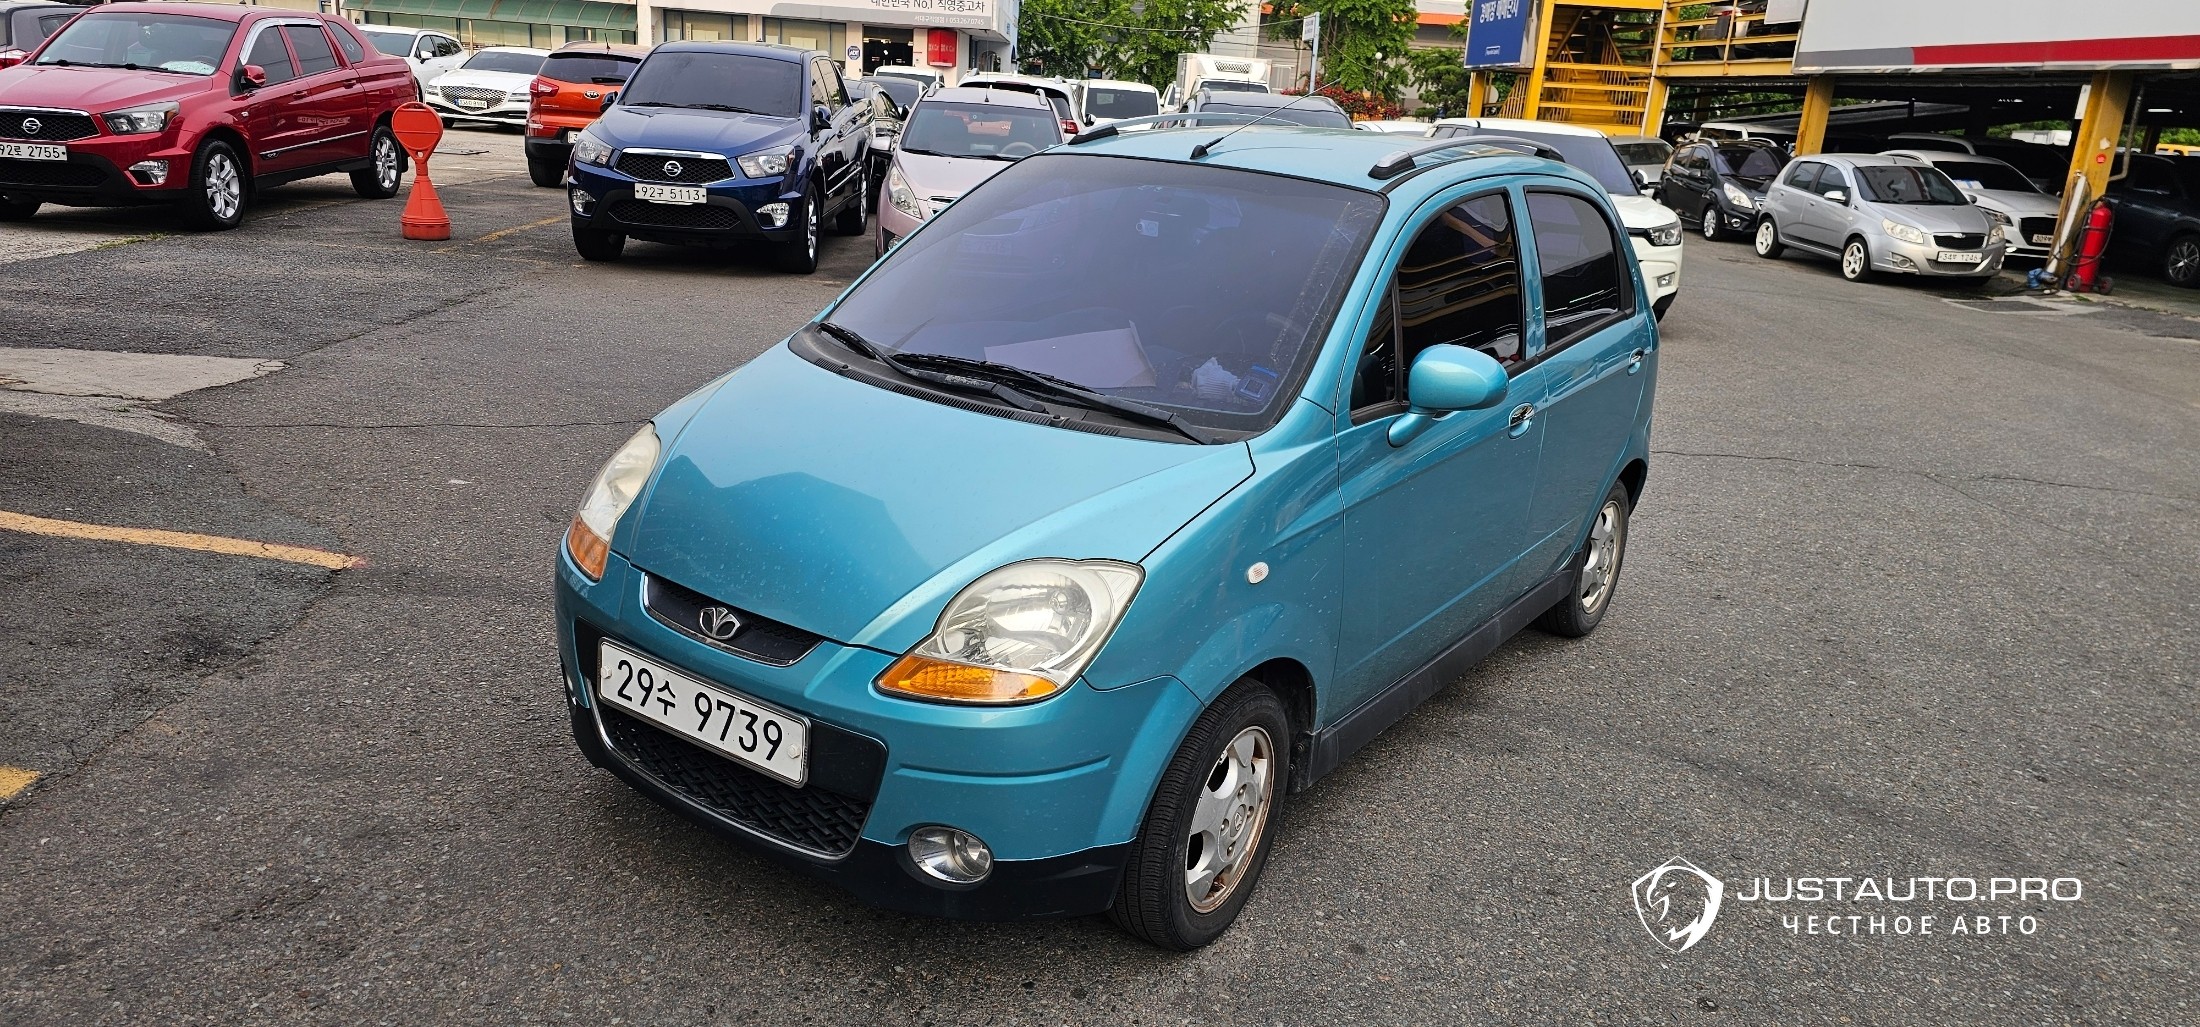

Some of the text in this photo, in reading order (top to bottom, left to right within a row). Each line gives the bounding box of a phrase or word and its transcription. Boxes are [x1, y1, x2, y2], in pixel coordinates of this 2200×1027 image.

[937, 0, 986, 13] 직영중고차
[27, 145, 60, 159] 2755
[641, 186, 700, 201] 92구 5113
[617, 659, 783, 761] 29수 9739
